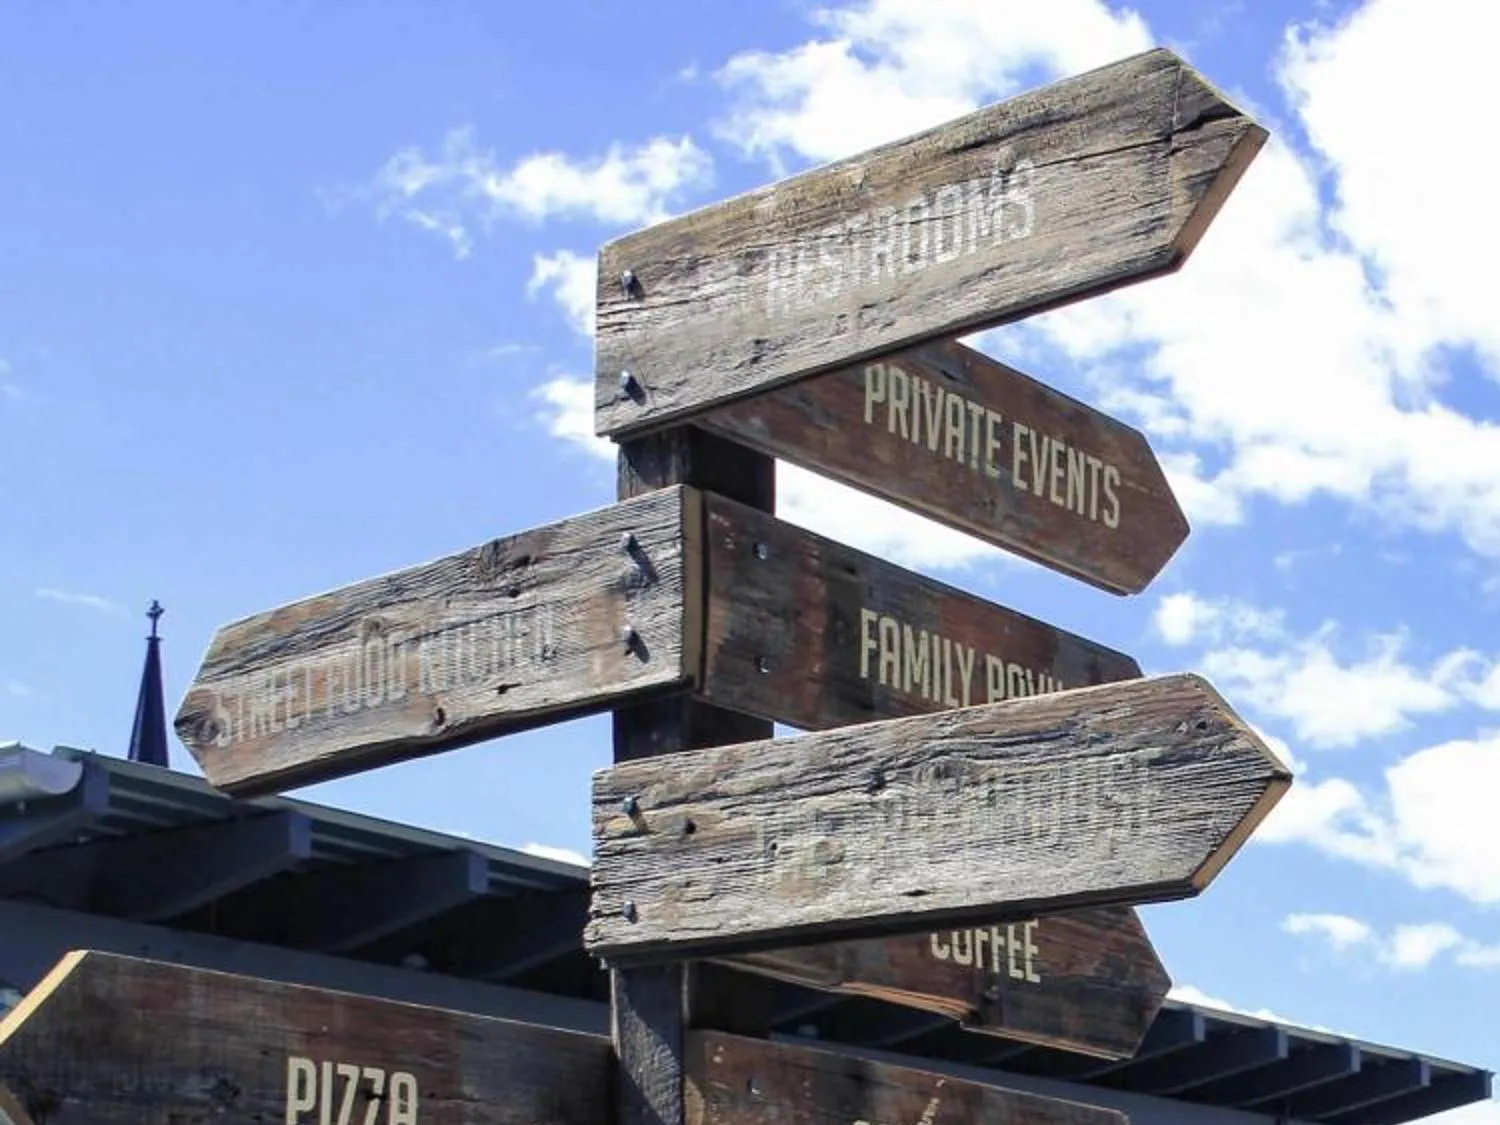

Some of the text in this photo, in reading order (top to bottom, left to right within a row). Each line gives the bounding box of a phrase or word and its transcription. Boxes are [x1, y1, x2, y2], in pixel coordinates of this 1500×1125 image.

[767, 158, 1034, 319] RESTROOMS
[864, 363, 1121, 529] PRIVATE EVENTS
[860, 607, 975, 708] FAMILY
